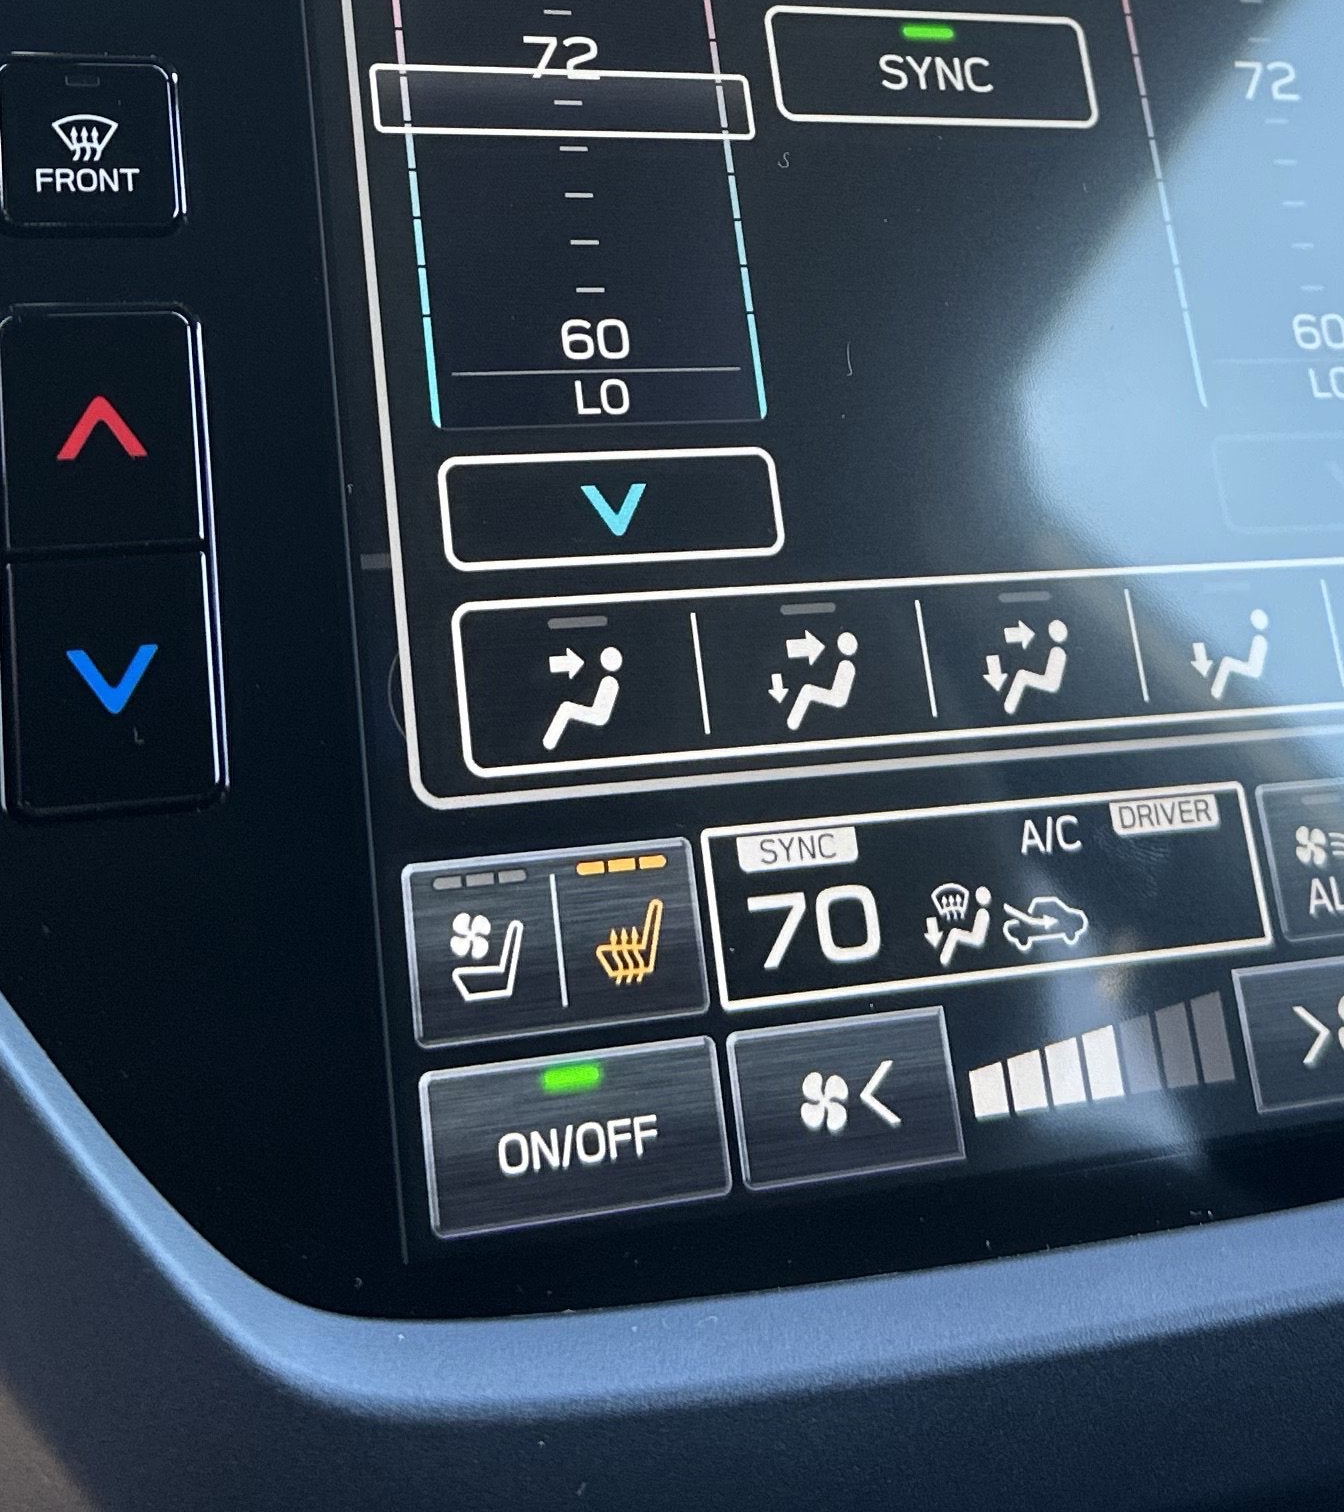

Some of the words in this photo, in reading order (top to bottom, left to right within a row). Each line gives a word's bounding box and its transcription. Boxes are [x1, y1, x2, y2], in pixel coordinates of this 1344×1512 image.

[522, 35, 601, 81] 72
[877, 54, 995, 94] SYNC
[1233, 60, 1301, 102] 72
[34, 167, 141, 193] FRONT
[560, 317, 631, 361] 60
[573, 377, 631, 416] LO
[1020, 814, 1083, 856] A/C
[1116, 798, 1214, 832] DRIVER
[758, 831, 839, 866] SYNC
[746, 883, 882, 970] 70
[497, 1113, 659, 1176] ON/OFF
